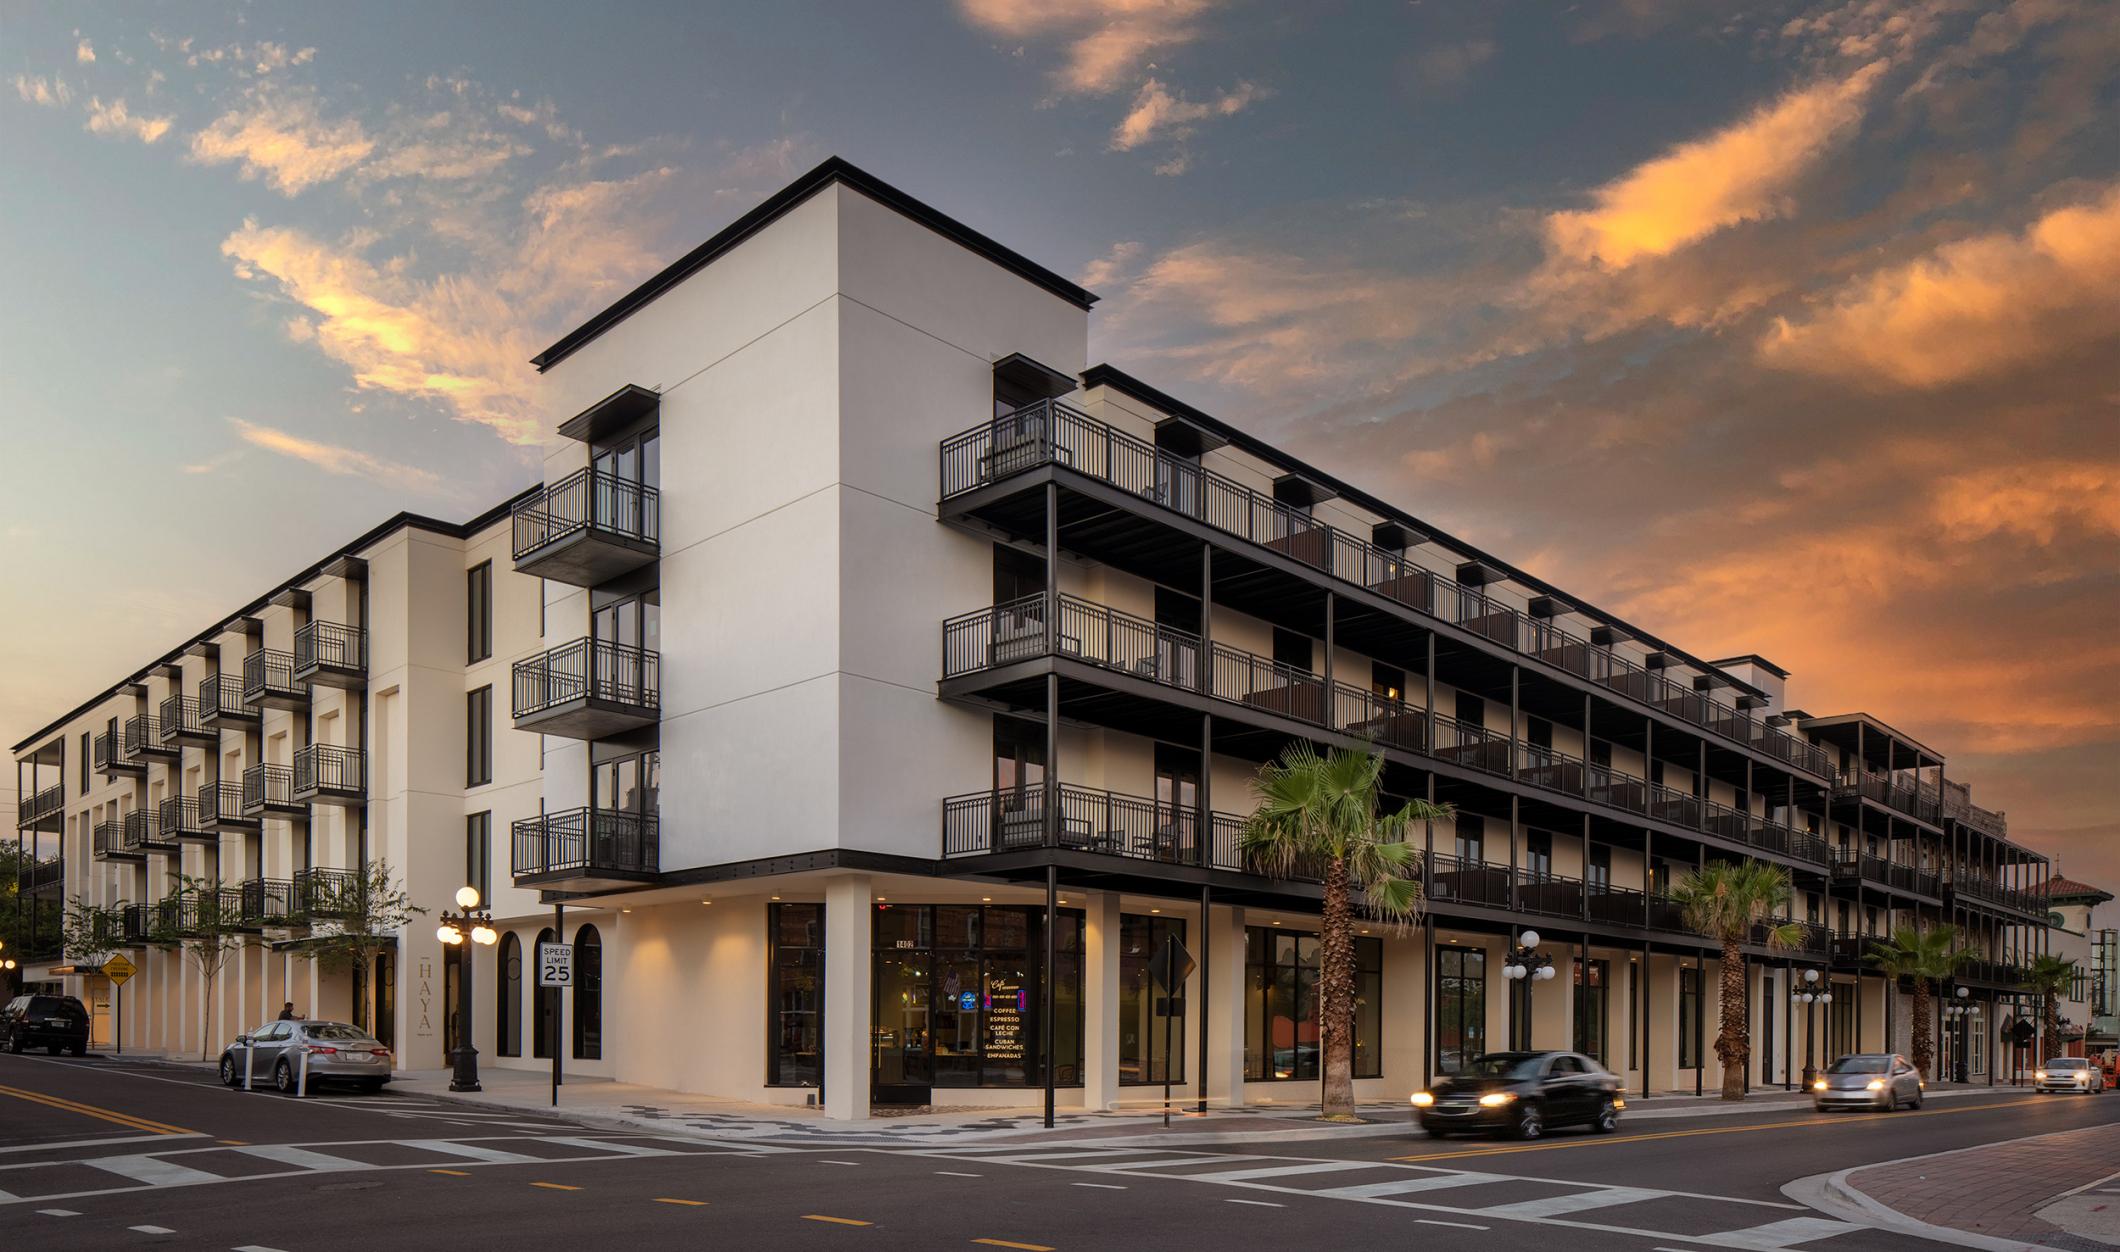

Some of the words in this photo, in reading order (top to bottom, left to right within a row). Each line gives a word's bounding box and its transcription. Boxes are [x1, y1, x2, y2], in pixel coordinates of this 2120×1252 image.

[544, 947, 571, 956] SPEED
[545, 966, 570, 981] 25
[419, 963, 432, 1029] HAYA
